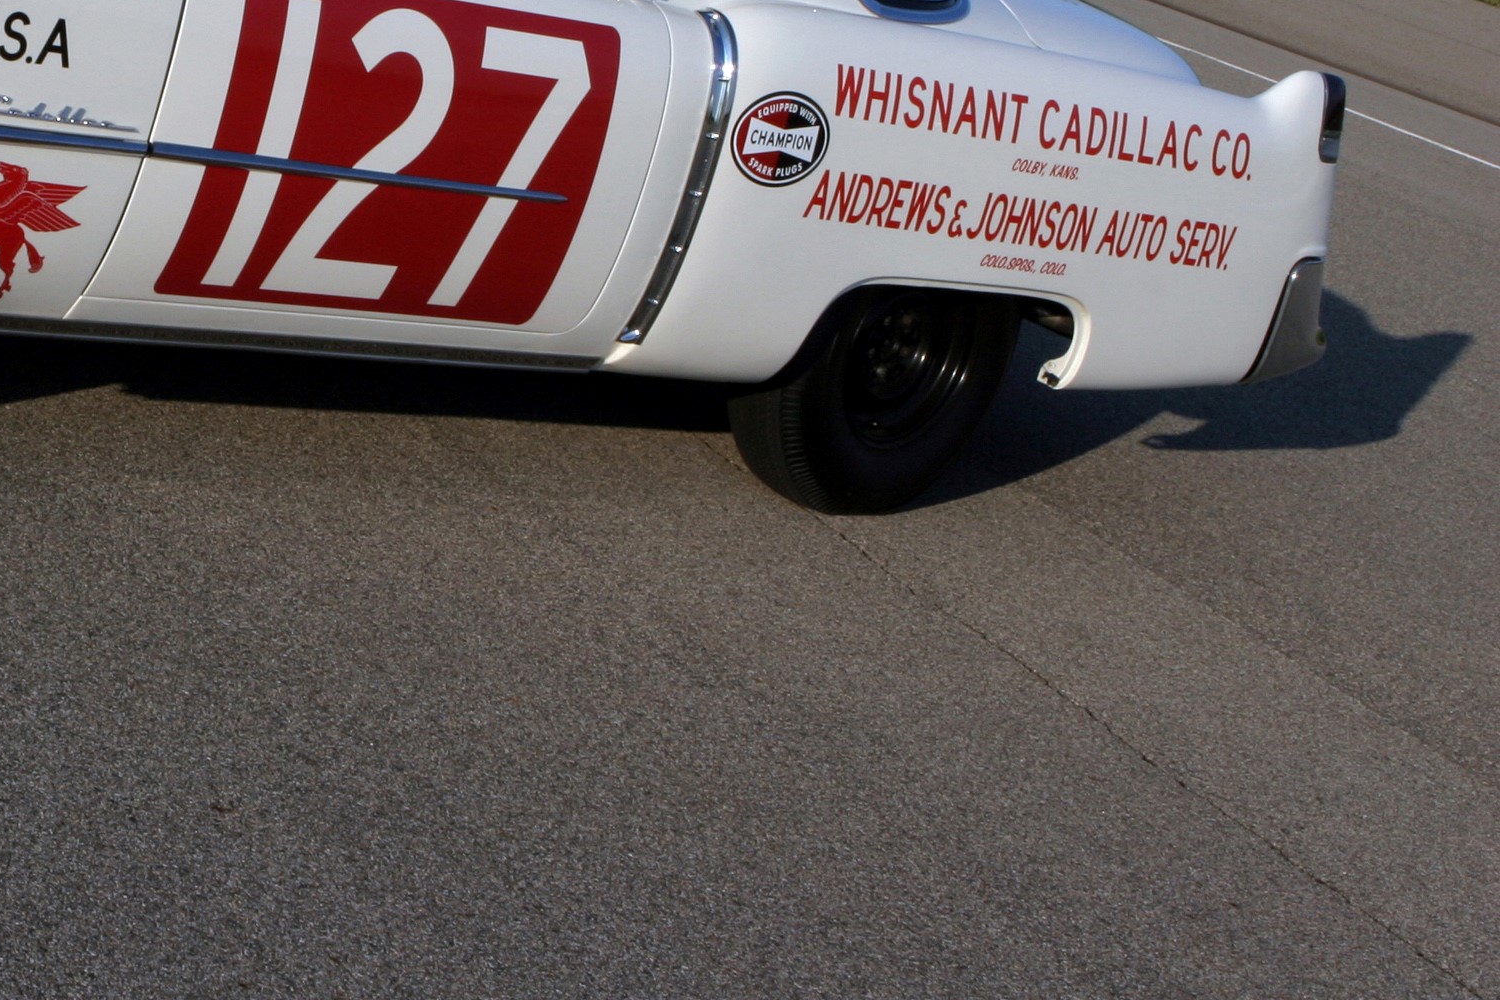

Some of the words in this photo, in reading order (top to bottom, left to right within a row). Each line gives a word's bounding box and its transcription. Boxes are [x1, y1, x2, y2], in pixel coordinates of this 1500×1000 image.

[757, 102, 798, 119] EQUIPPED
[799, 106, 817, 126] WITH
[835, 63, 1028, 144] WHISNANT
[1038, 99, 1202, 172] CADILLAC
[1211, 129, 1252, 182] CO.
[750, 129, 813, 151] CHAMPION
[748, 157, 773, 177] SPARK
[775, 162, 803, 177] PLUGS
[1049, 164, 1079, 180] KANS.
[803, 169, 952, 235] ANDREWS
[965, 192, 1099, 254] JOHNSON
[1097, 209, 1167, 262] AUTO
[1170, 219, 1238, 271] SERV.
